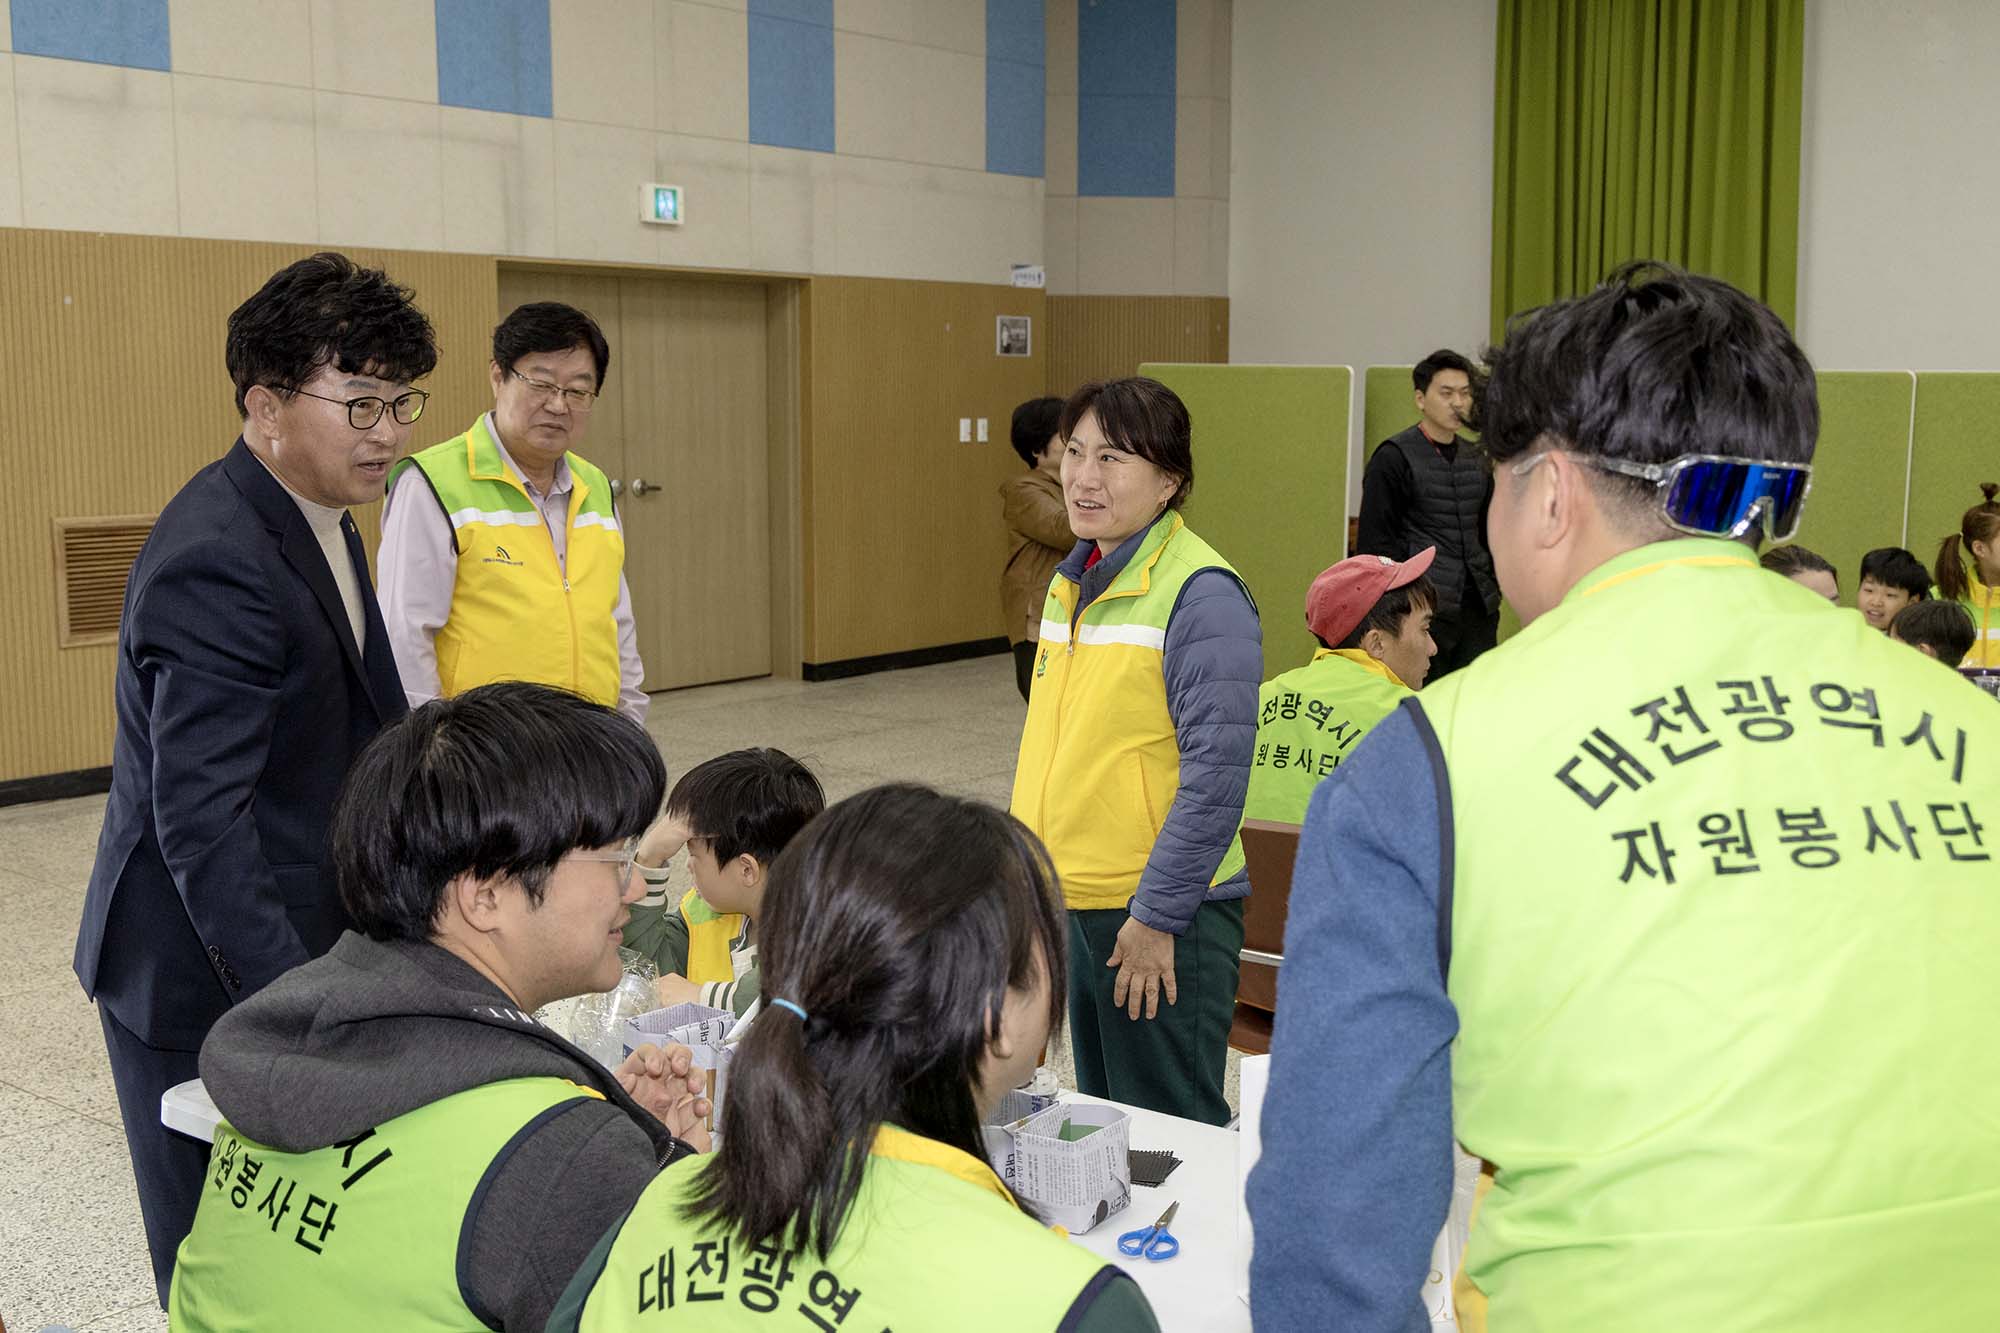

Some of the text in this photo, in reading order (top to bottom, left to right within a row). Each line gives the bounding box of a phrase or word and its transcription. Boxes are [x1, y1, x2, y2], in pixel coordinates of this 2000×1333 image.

[1256, 692, 1362, 750] 전광역시
[1554, 675, 1967, 811] 대전광역시
[1611, 799, 1991, 885] 자원봉사단
[638, 1236, 893, 1333] 대전광역
